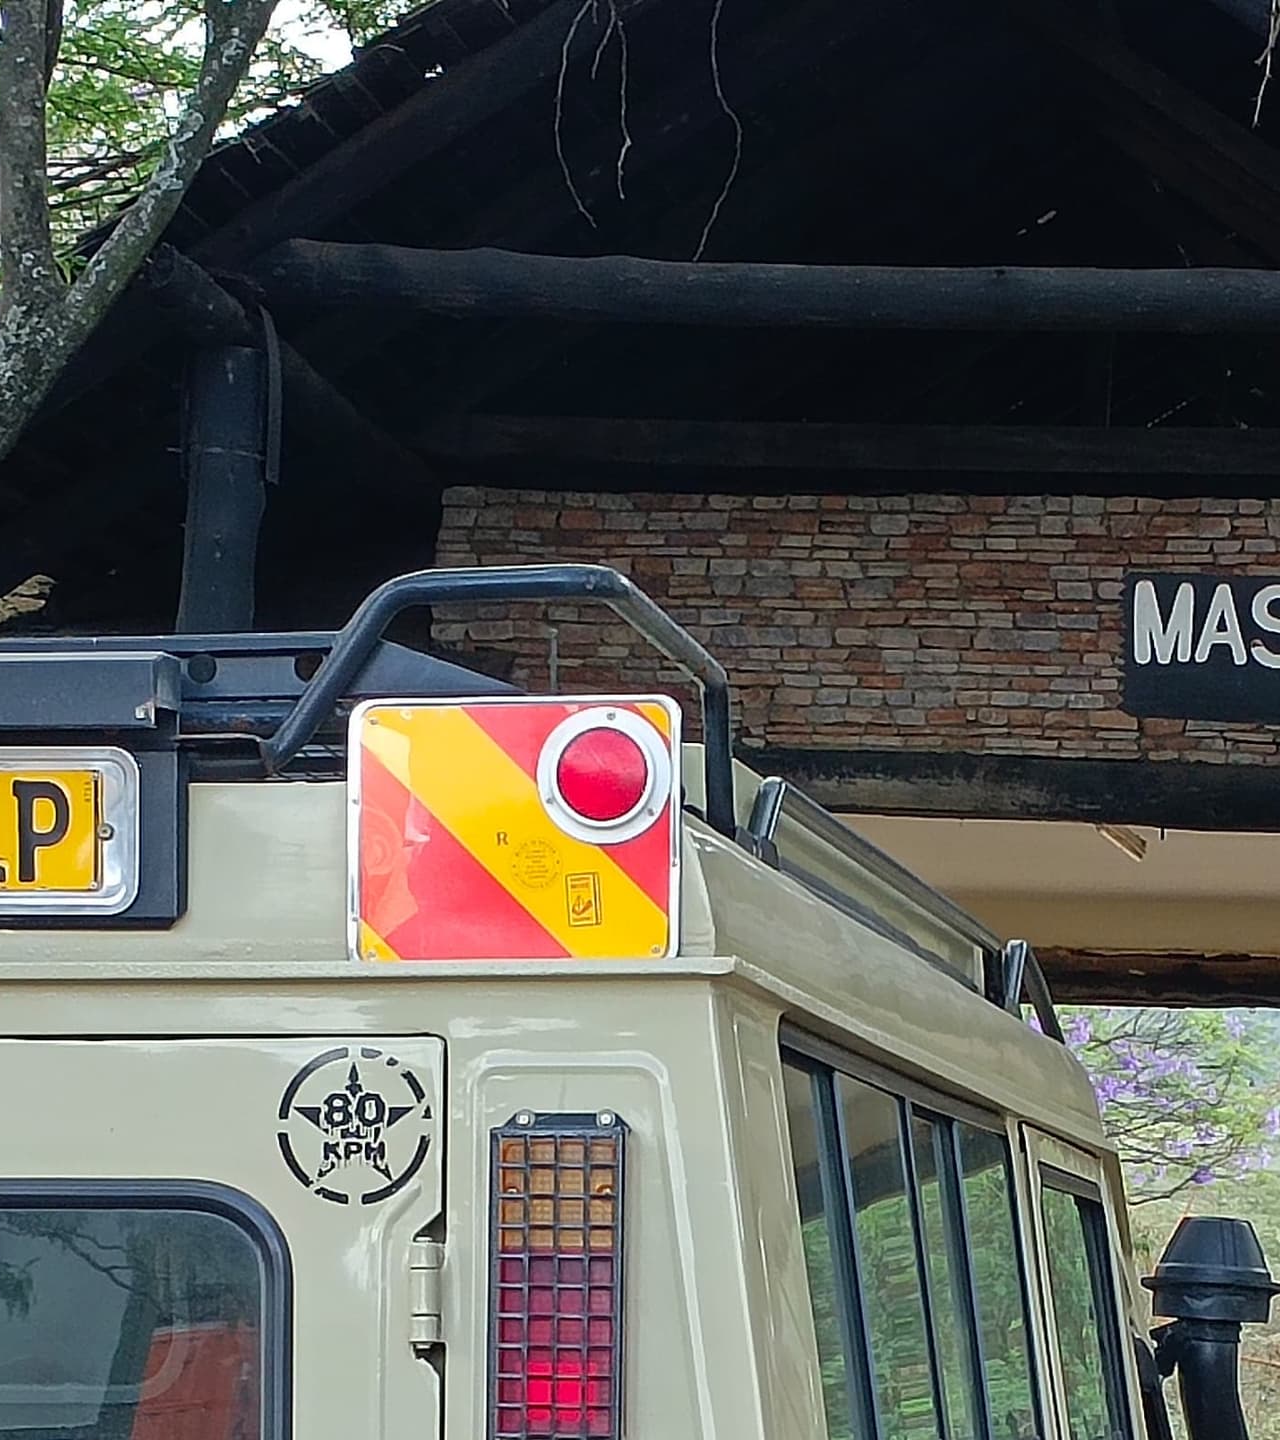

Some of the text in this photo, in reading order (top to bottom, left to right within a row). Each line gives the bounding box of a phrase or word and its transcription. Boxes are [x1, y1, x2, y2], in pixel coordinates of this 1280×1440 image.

[496, 831, 509, 846] R
[323, 1092, 386, 1127] 80
[323, 1141, 386, 1161] KPH
